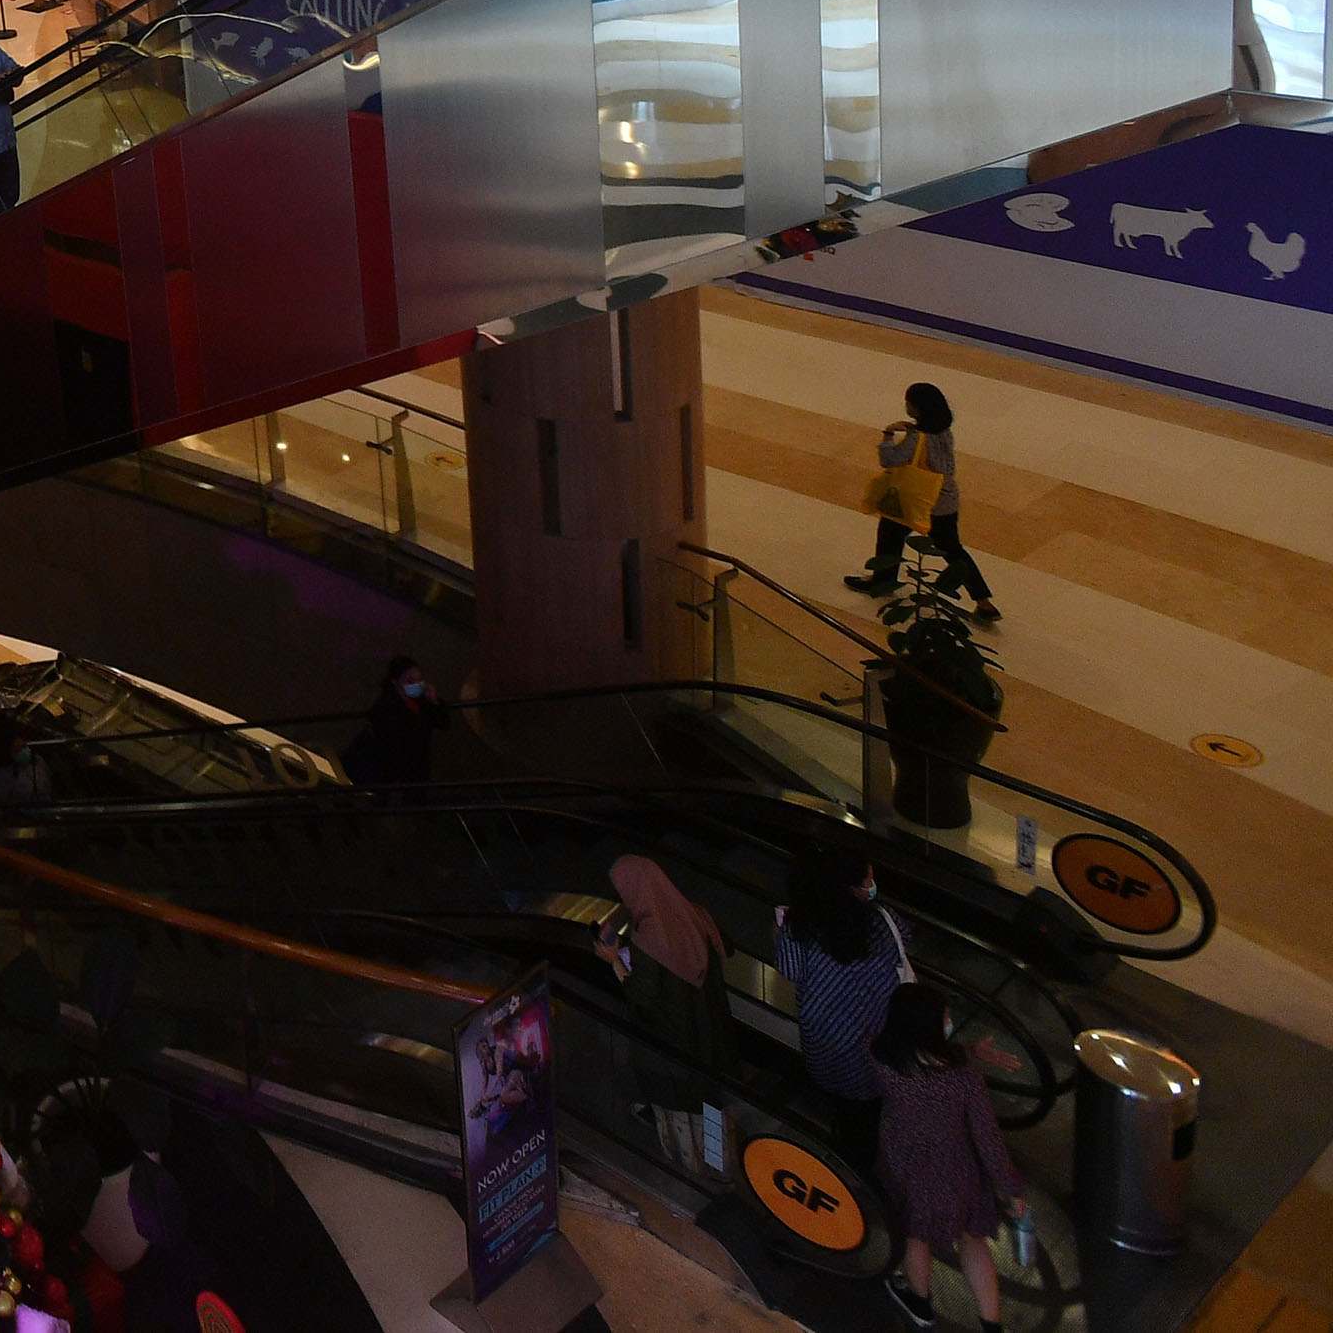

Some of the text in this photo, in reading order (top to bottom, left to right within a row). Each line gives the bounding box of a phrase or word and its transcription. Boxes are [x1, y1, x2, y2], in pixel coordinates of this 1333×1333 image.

[1086, 865, 1152, 898] GF
[477, 1129, 546, 1194] NOW OPEN
[481, 1195, 498, 1220] FIT
[501, 1167, 534, 1203] PLAN
[773, 1169, 841, 1214] GF
